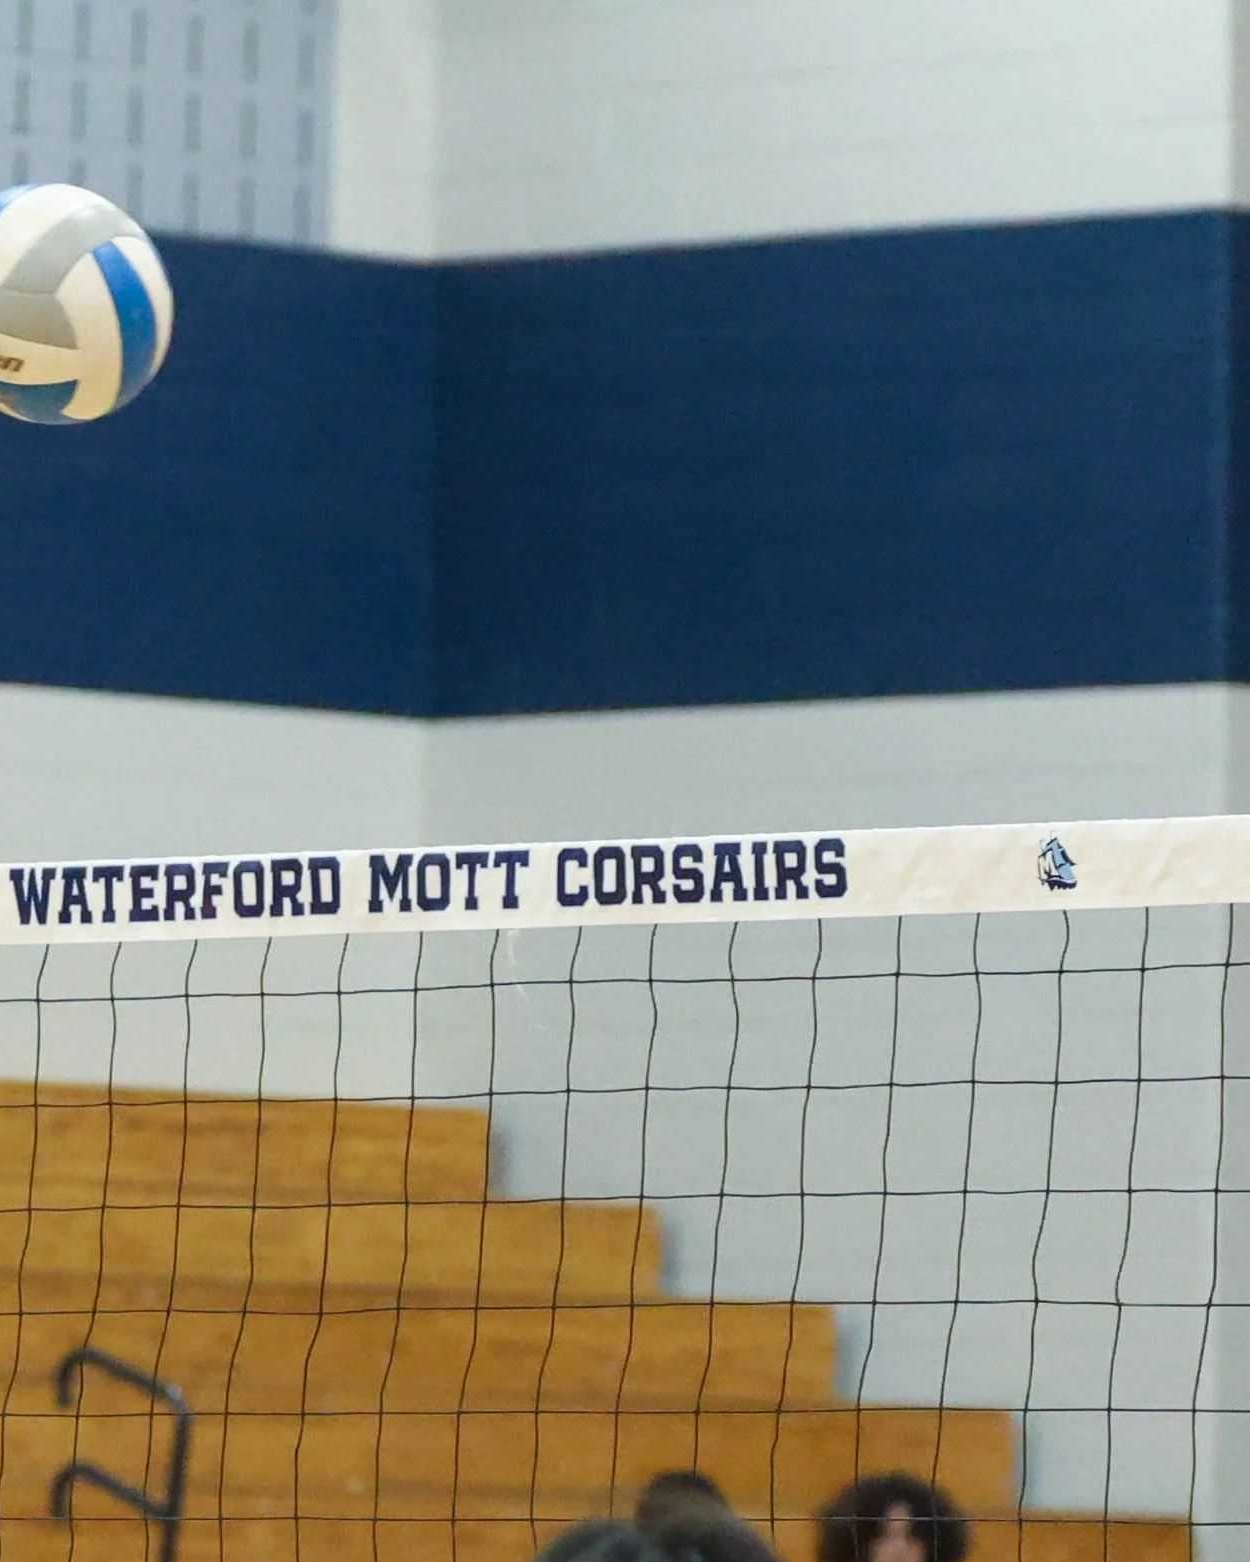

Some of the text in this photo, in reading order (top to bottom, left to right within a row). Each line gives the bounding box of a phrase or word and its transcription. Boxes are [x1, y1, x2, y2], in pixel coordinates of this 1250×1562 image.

[9, 838, 848, 925] WATERFORD MOTT CORSAIRS
